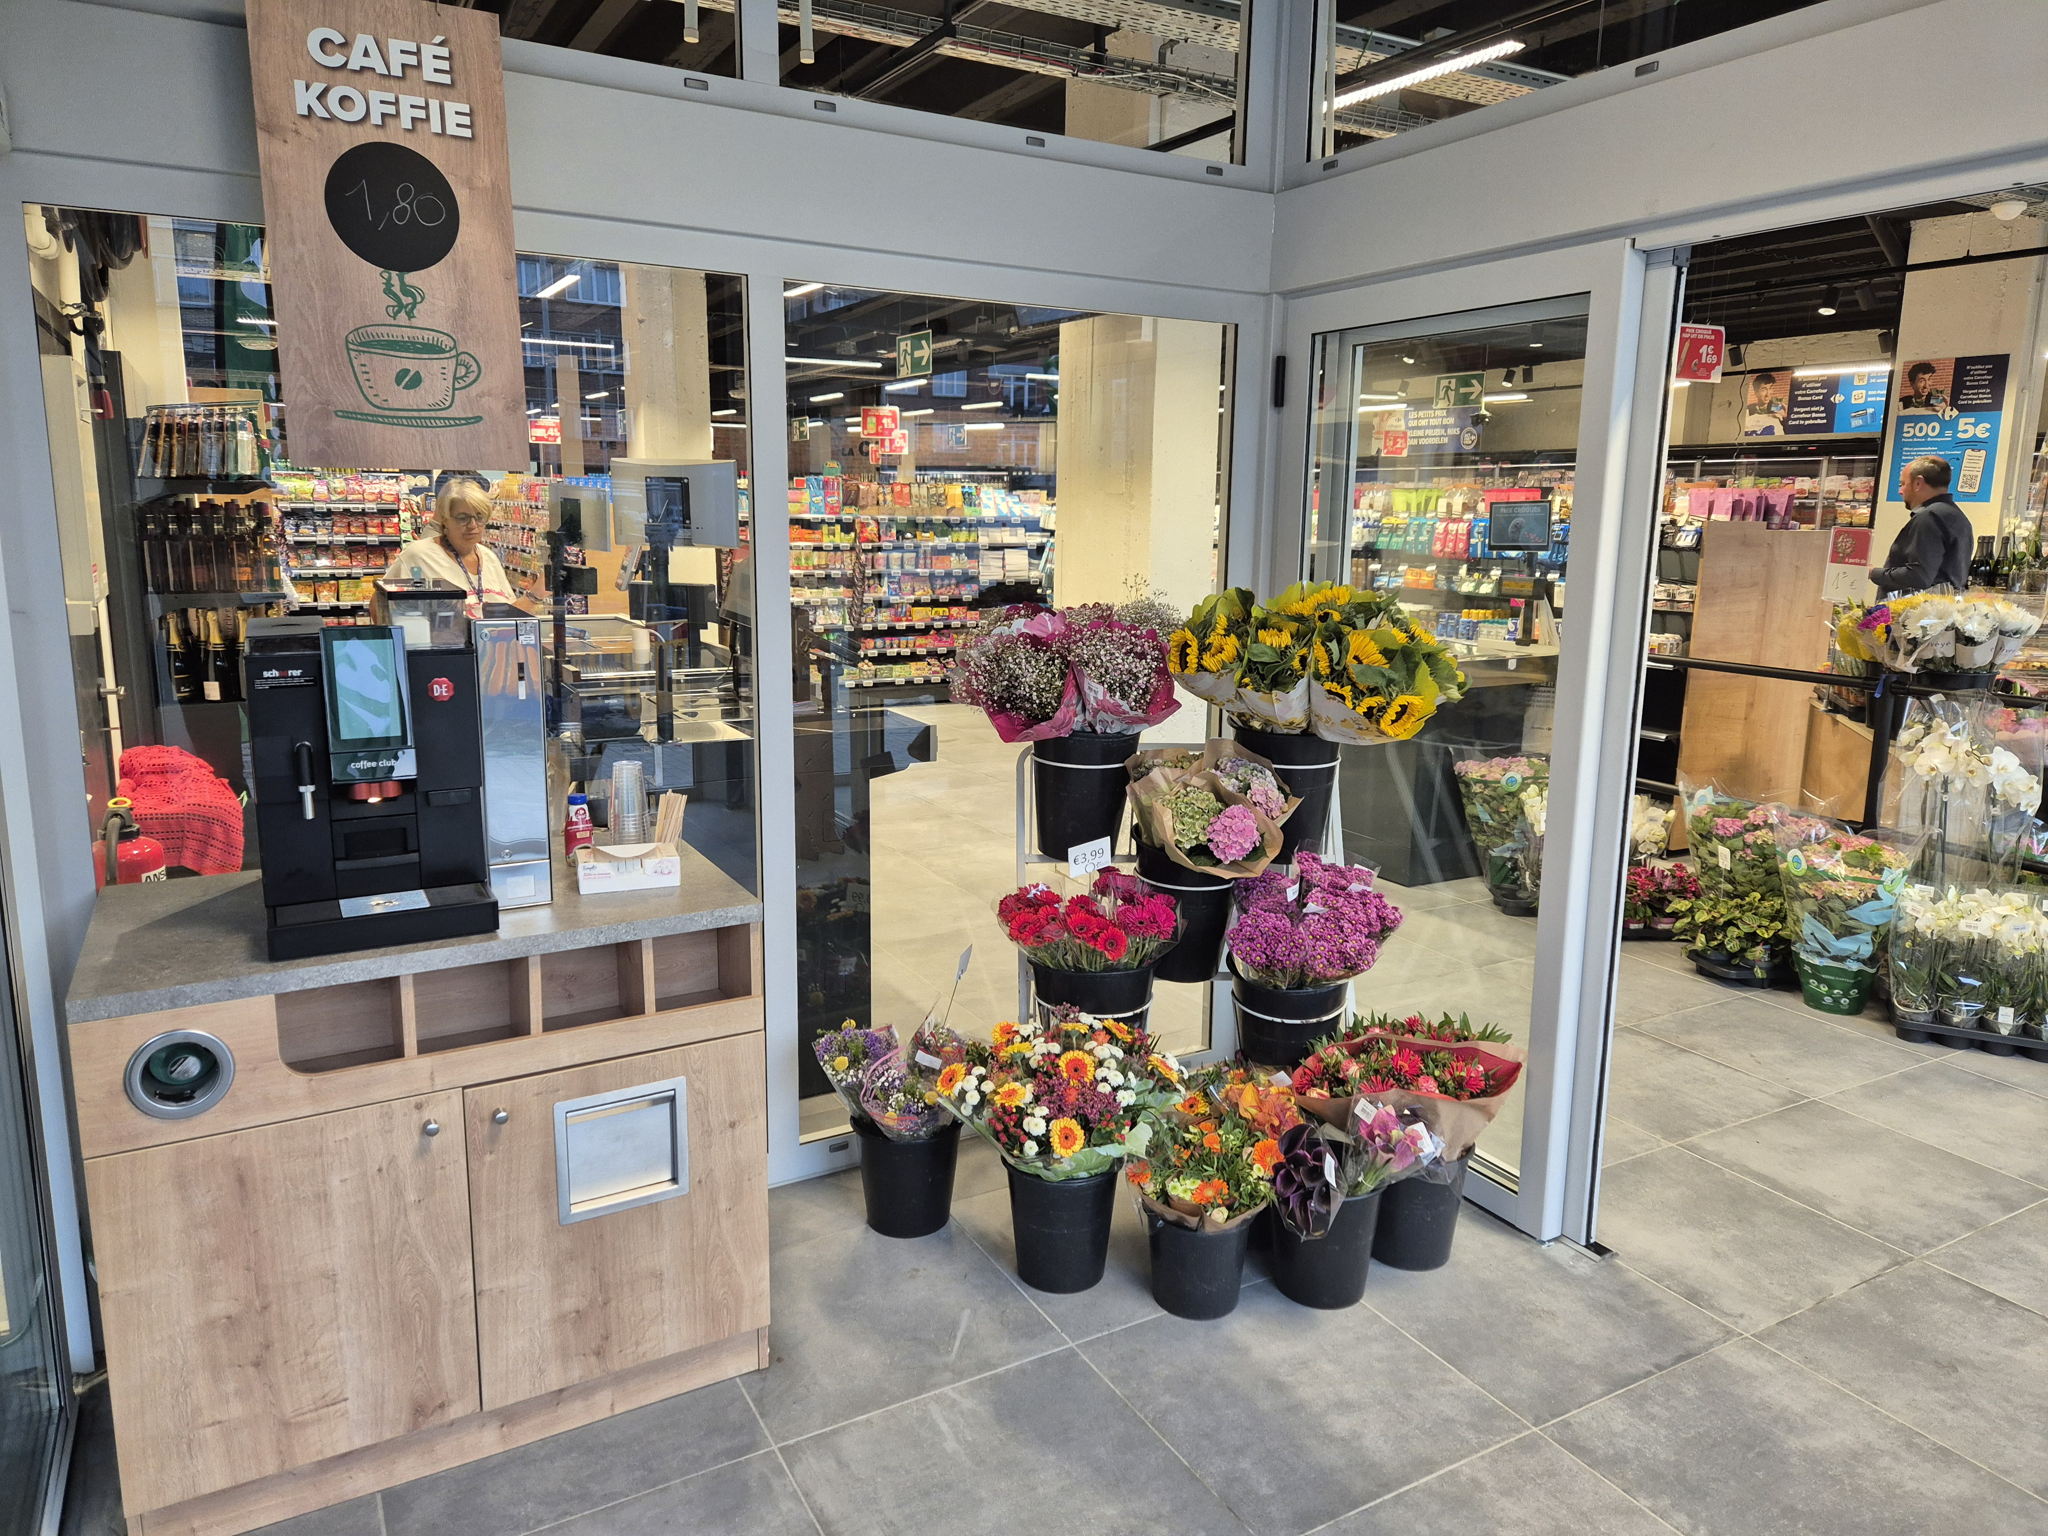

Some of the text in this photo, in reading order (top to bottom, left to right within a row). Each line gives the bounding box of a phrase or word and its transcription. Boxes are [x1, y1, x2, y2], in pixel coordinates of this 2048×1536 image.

[306, 27, 452, 84] CAFÉ
[293, 79, 472, 138] KOFFIE
[345, 179, 446, 230] 1,80
[1435, 409, 1447, 417] PRIX
[1902, 421, 1941, 438] 500
[1956, 417, 1992, 439] 5€
[350, 758, 397, 770] coffee club
[1073, 847, 1105, 866] €3,99
